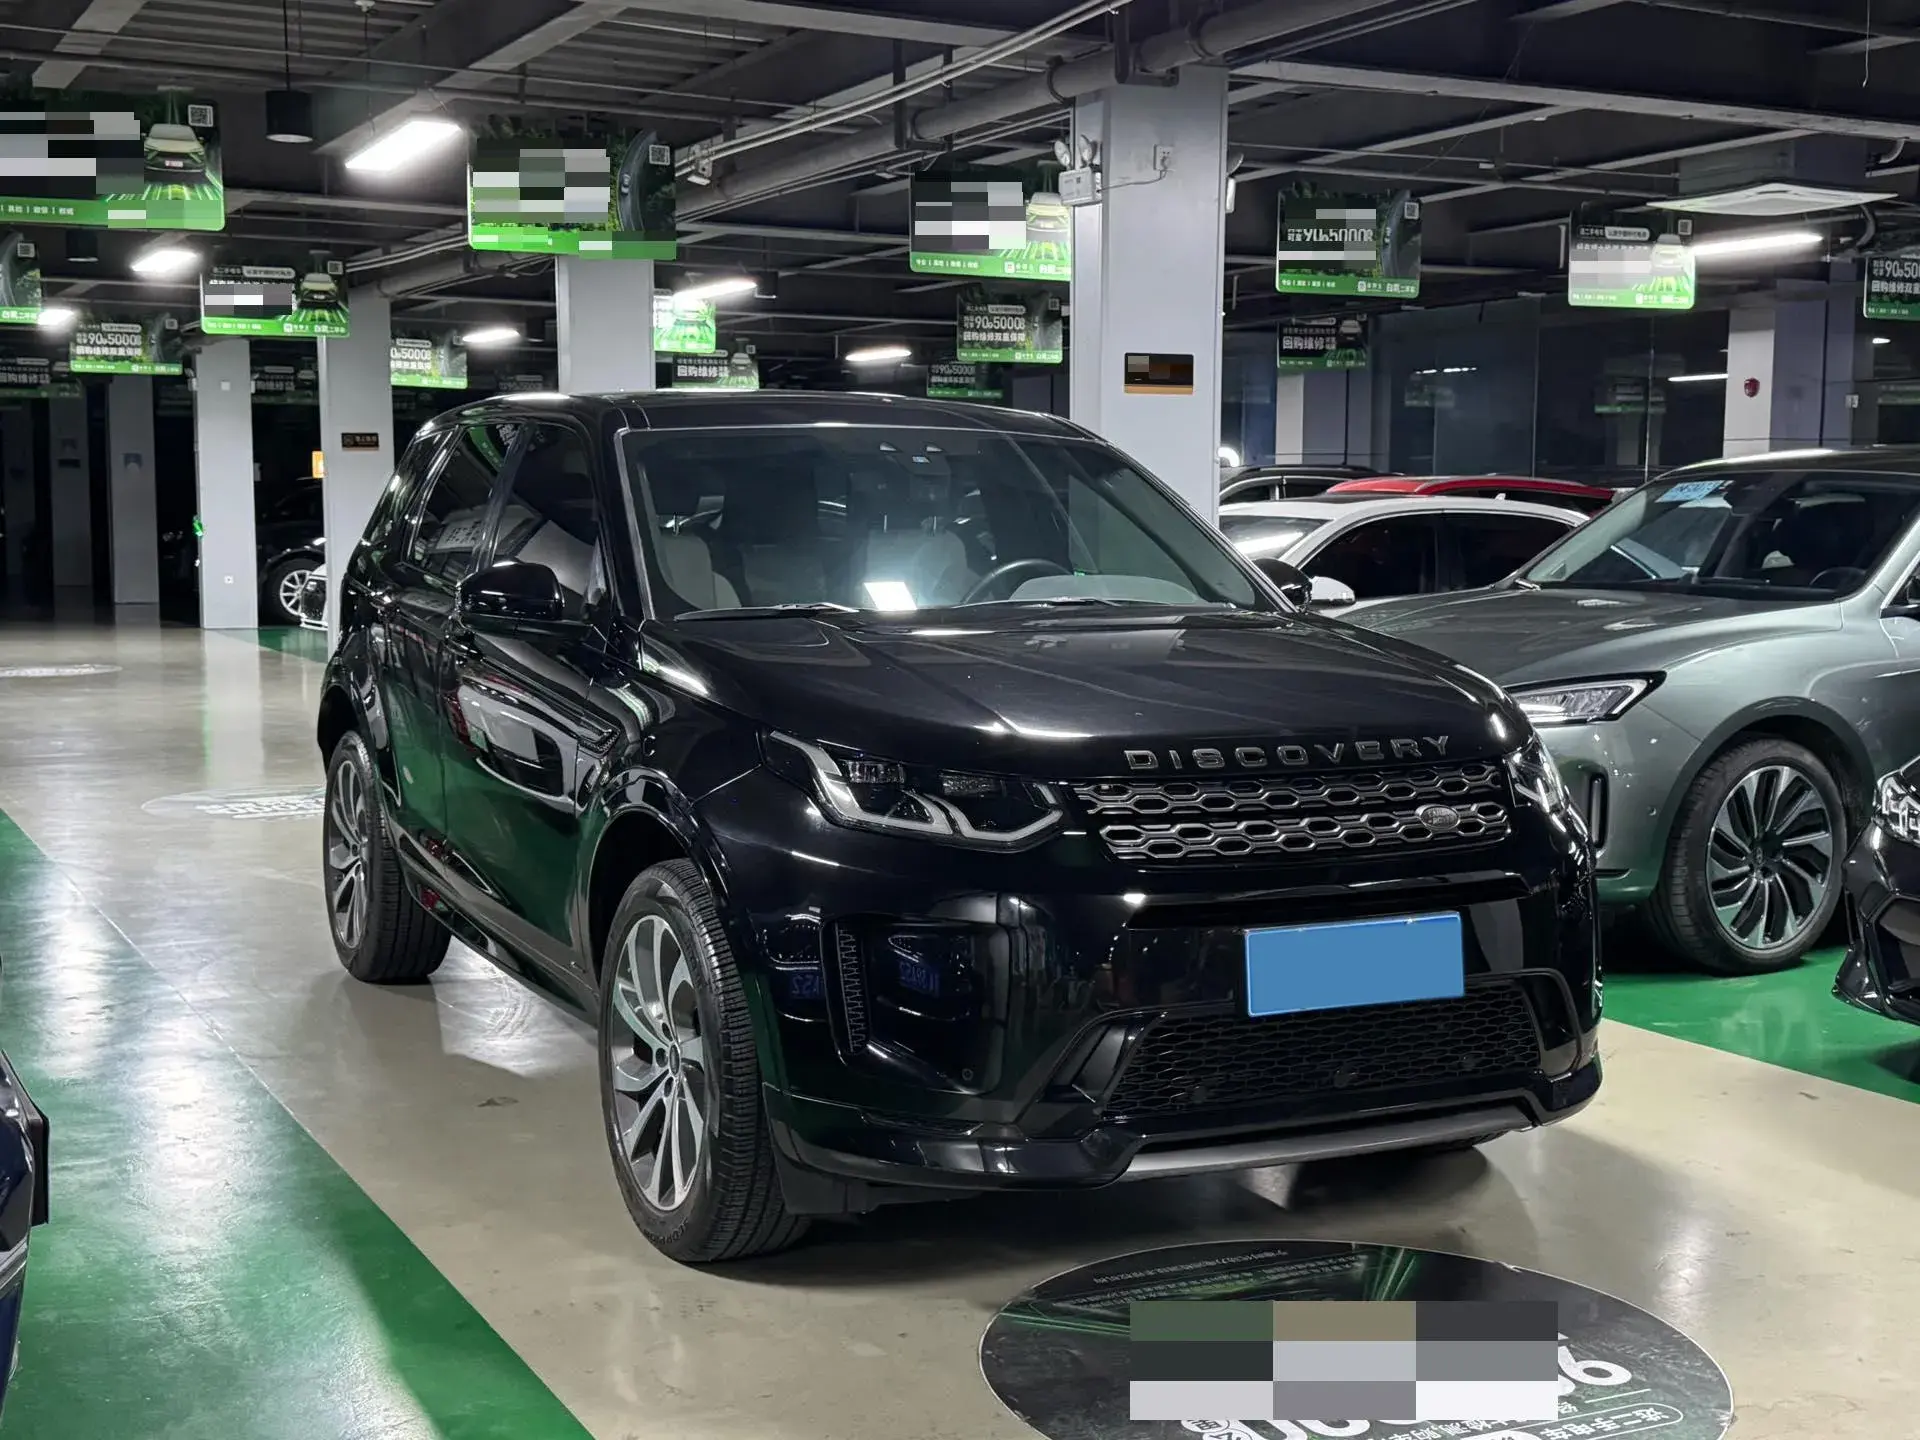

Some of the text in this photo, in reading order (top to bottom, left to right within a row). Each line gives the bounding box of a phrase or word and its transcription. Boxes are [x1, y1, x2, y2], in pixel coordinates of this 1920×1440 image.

[1123, 735, 1450, 771] DISCOVERY
[1540, 1407, 1669, 1440] 选二手电车
